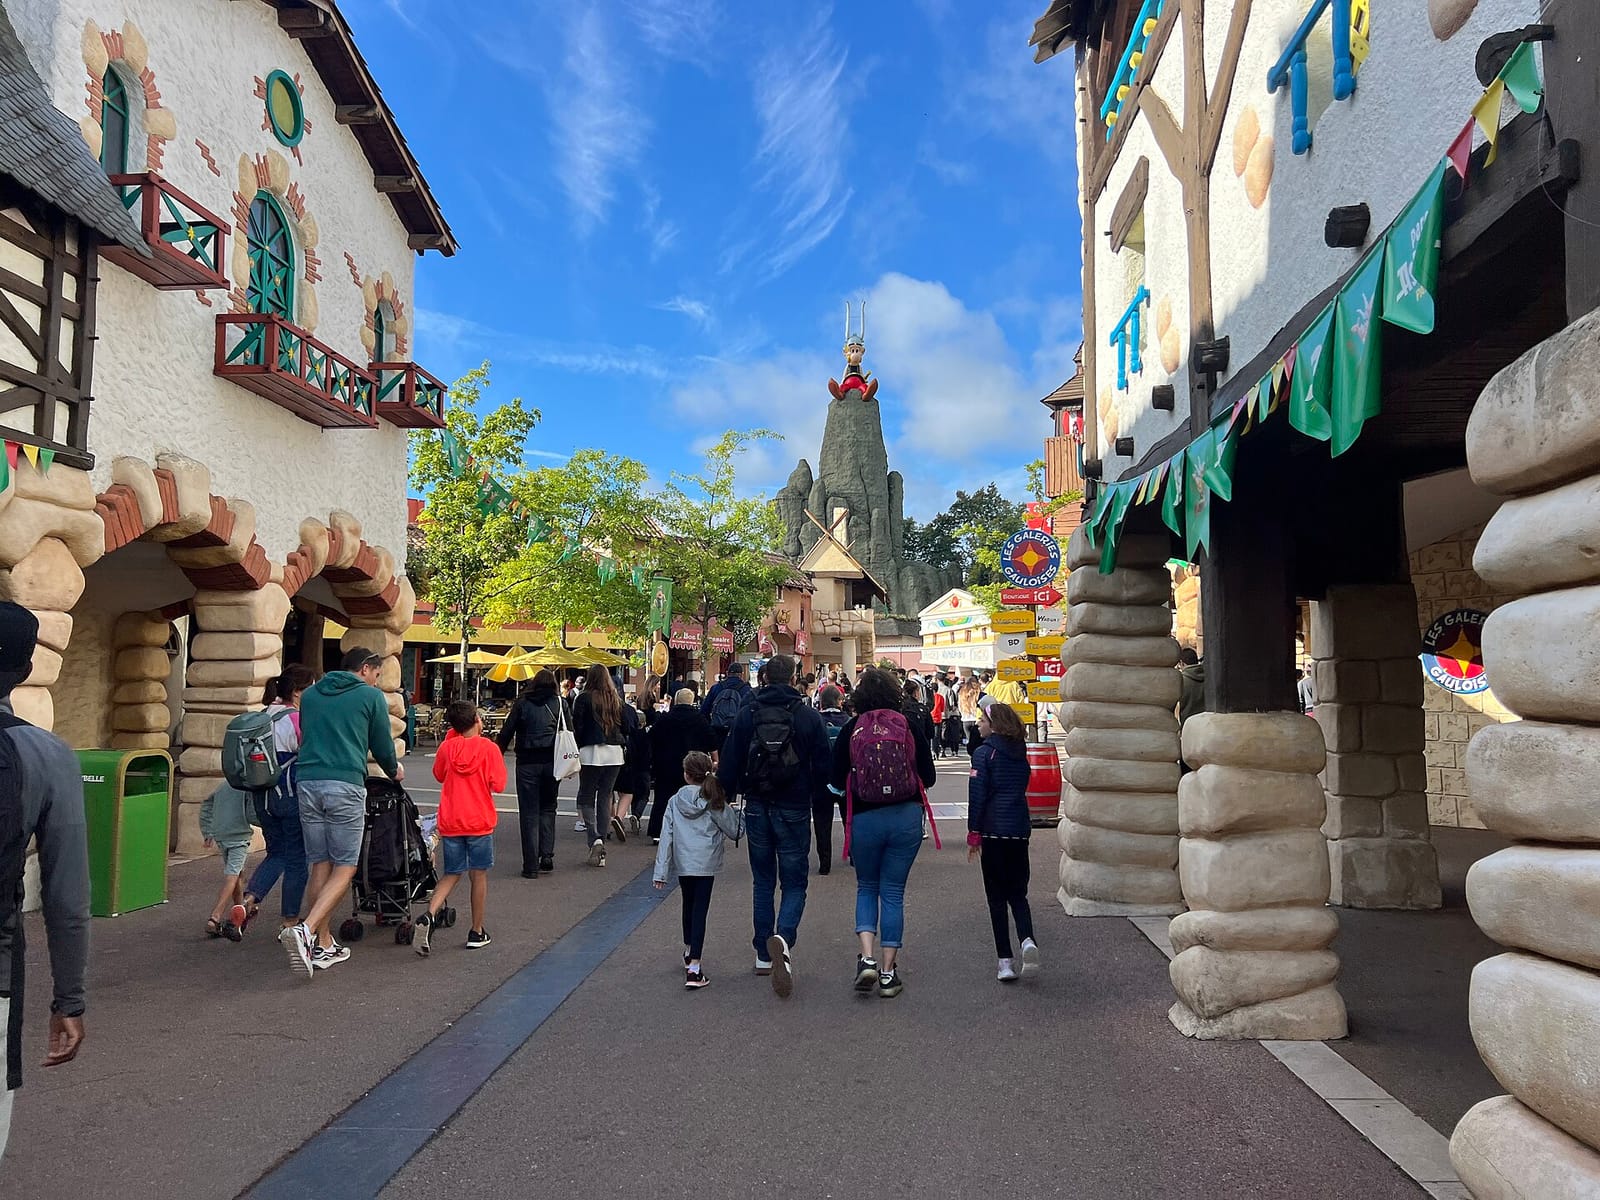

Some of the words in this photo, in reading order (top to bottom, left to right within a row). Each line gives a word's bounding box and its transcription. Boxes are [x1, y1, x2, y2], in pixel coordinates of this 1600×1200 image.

[1003, 541, 1015, 561] LES
[1014, 530, 1058, 560] GALERIES
[1004, 564, 1057, 587] GAULOISES
[1425, 622, 1442, 647] LES
[1430, 666, 1489, 691] GAULOIS
[1031, 687, 1058, 696] JOUE
[82, 774, 105, 783] BELLE
